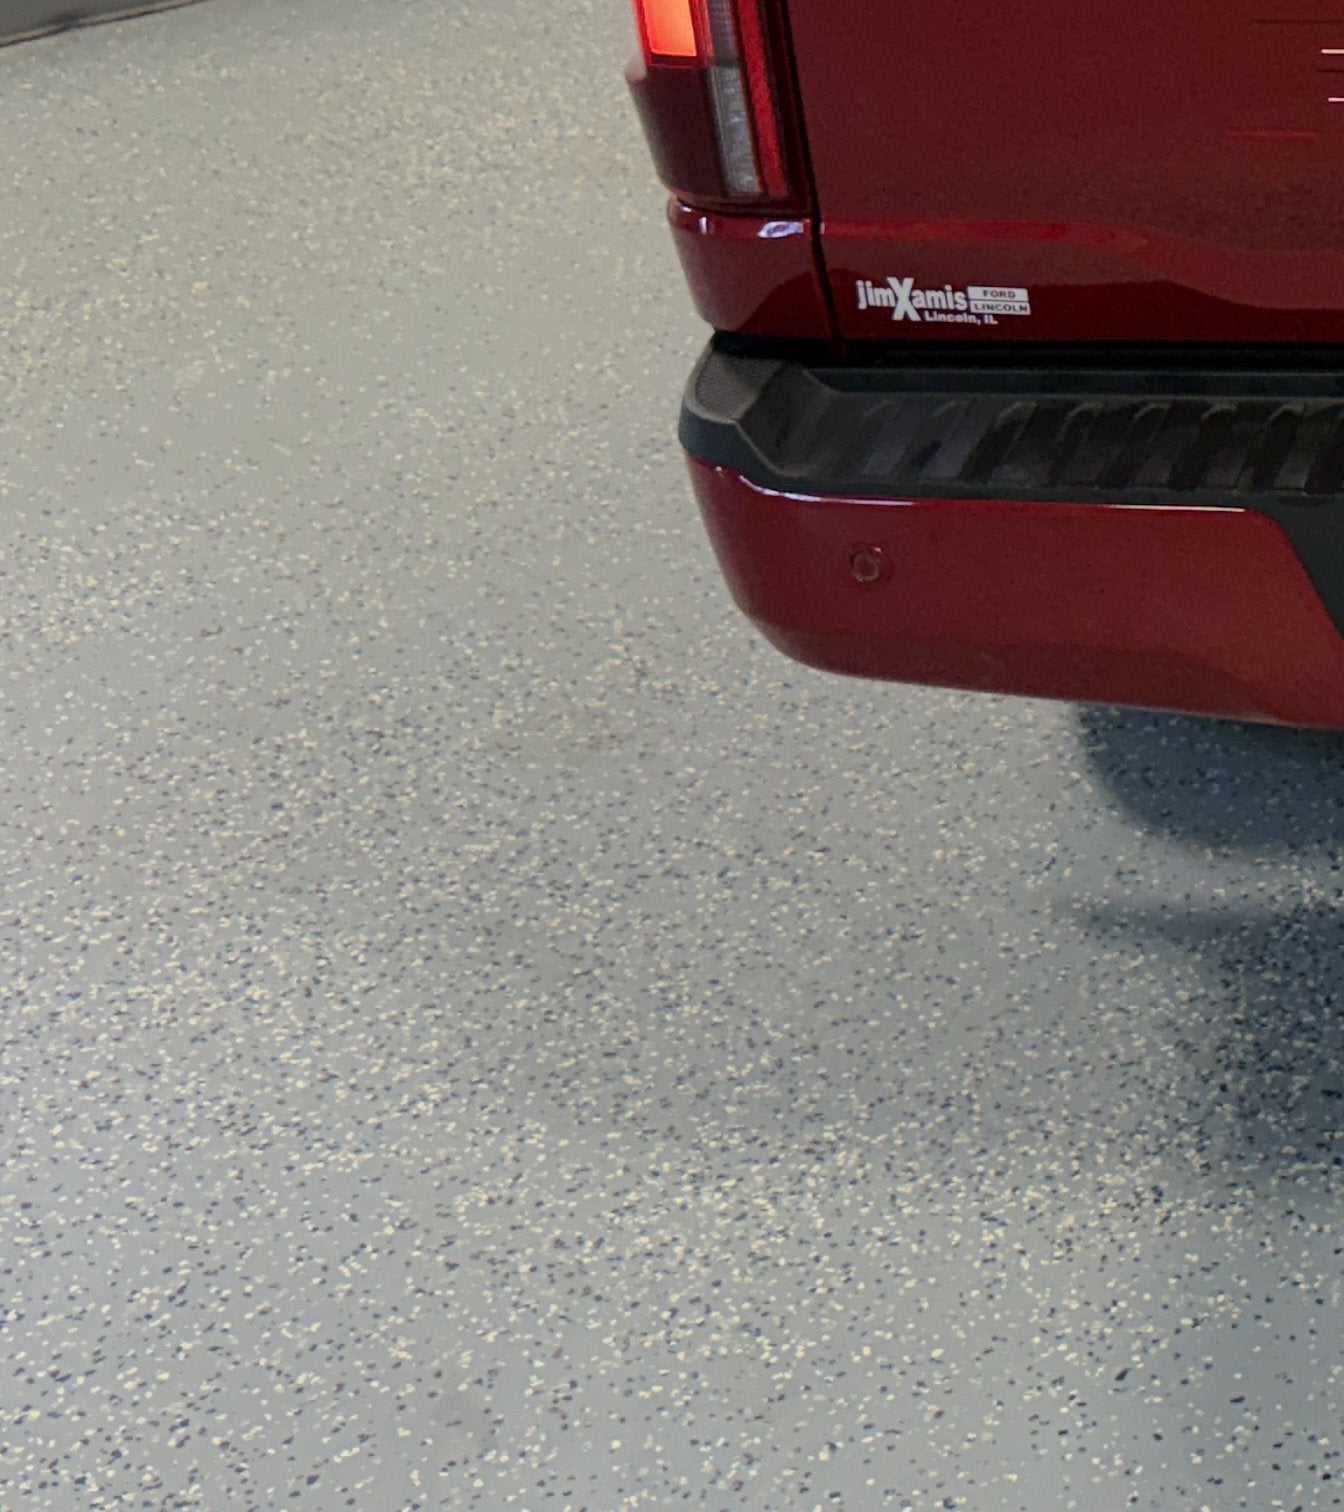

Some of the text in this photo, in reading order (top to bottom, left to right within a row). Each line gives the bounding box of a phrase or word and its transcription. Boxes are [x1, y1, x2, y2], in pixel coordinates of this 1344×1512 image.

[982, 289, 1016, 299] FORD
[973, 303, 1029, 313] LINCOLN
[924, 310, 999, 326] Lincoln, IL
